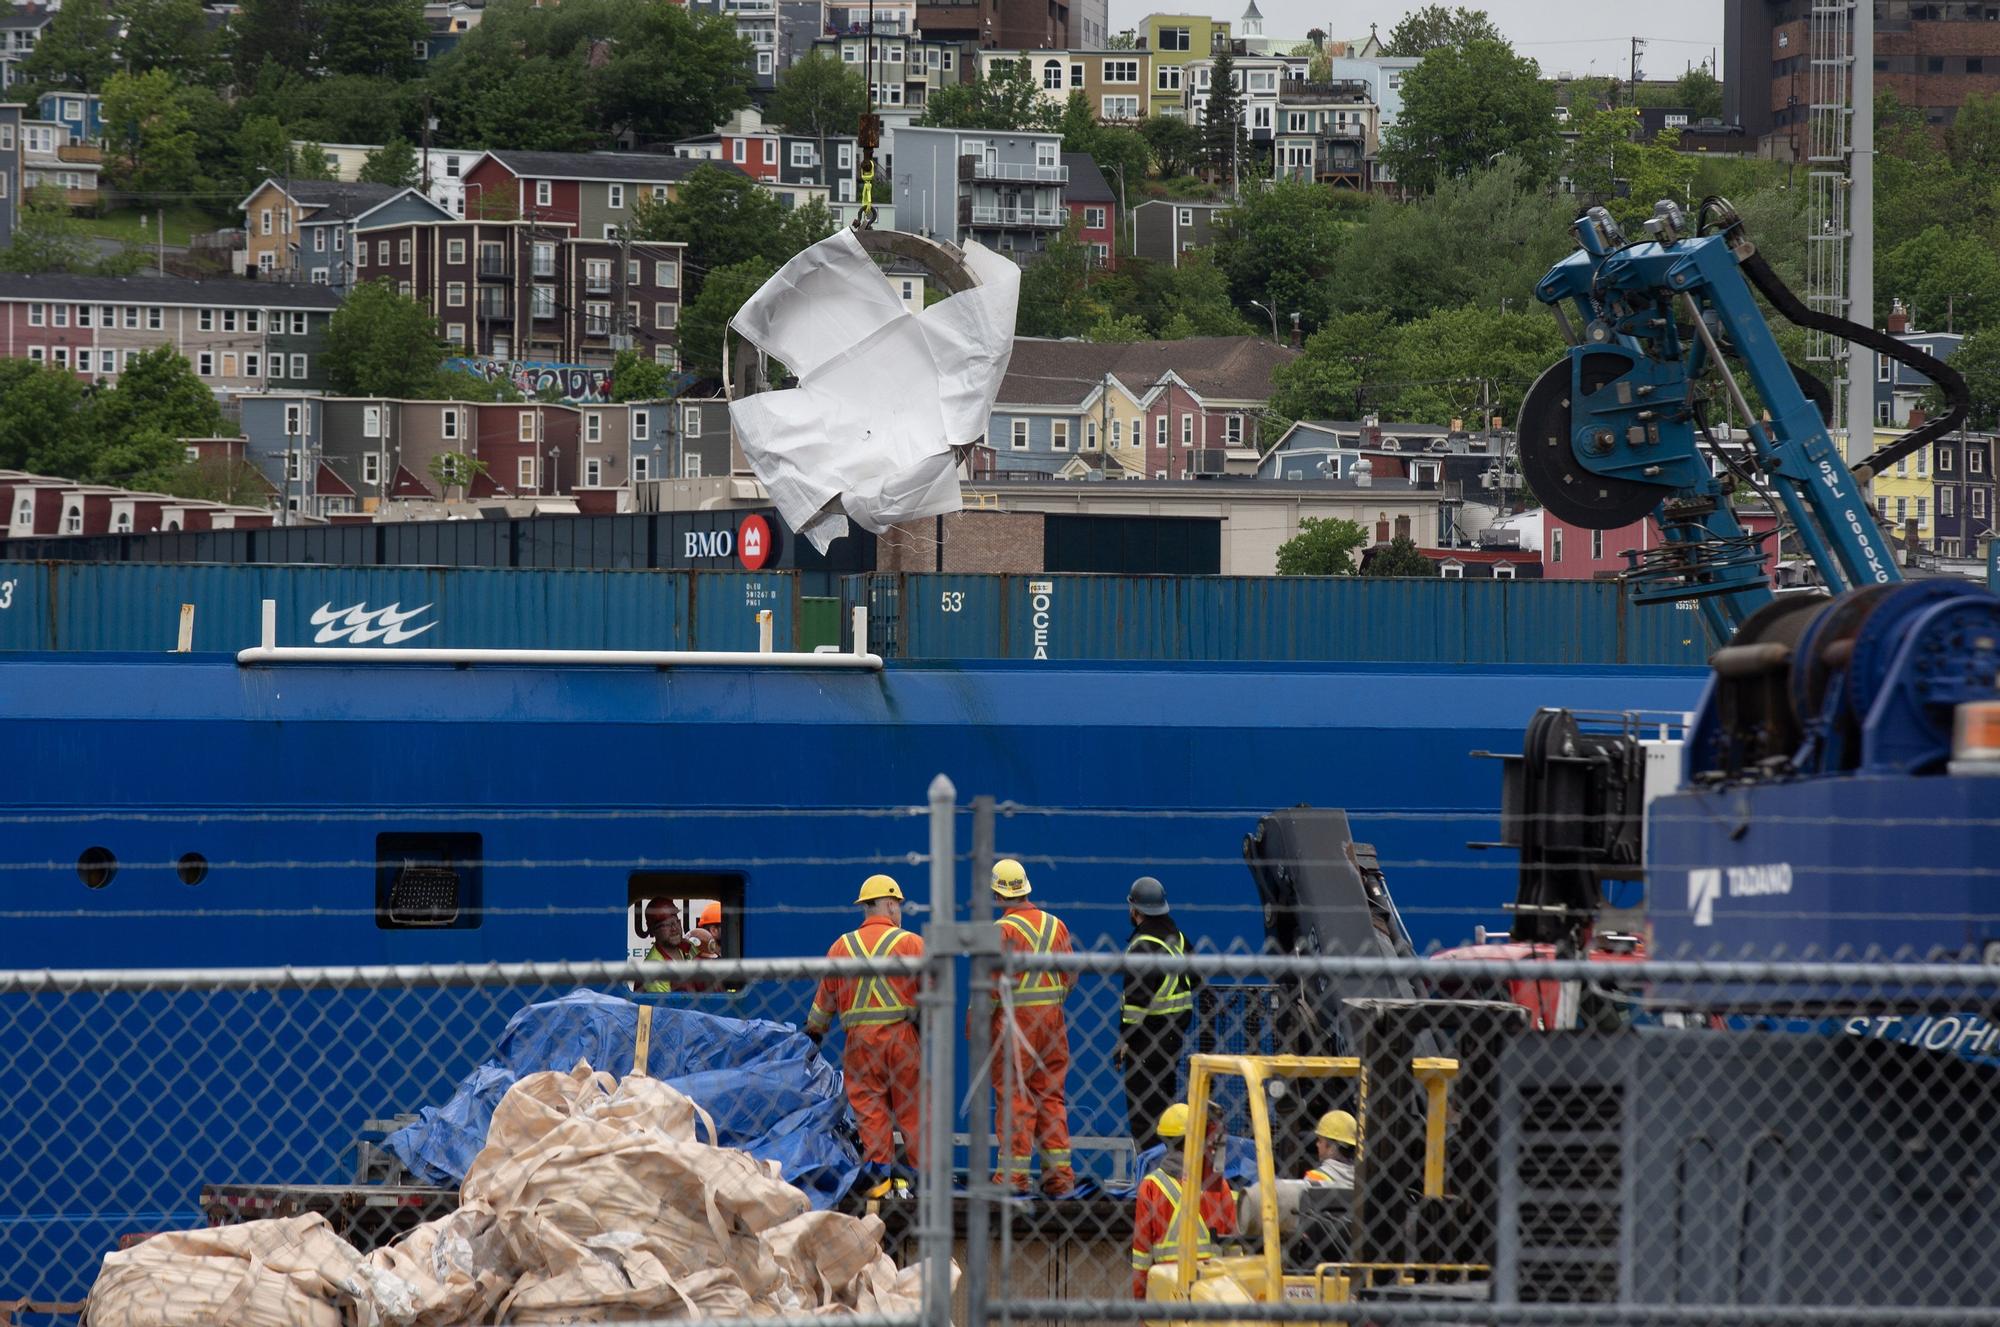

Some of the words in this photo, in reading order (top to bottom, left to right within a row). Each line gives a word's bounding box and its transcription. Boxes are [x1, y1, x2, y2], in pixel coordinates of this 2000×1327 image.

[1820, 461, 1845, 498] SWL
[1845, 509, 1888, 583] 6000KG
[684, 530, 732, 558] BMO
[941, 591, 965, 612] 53'
